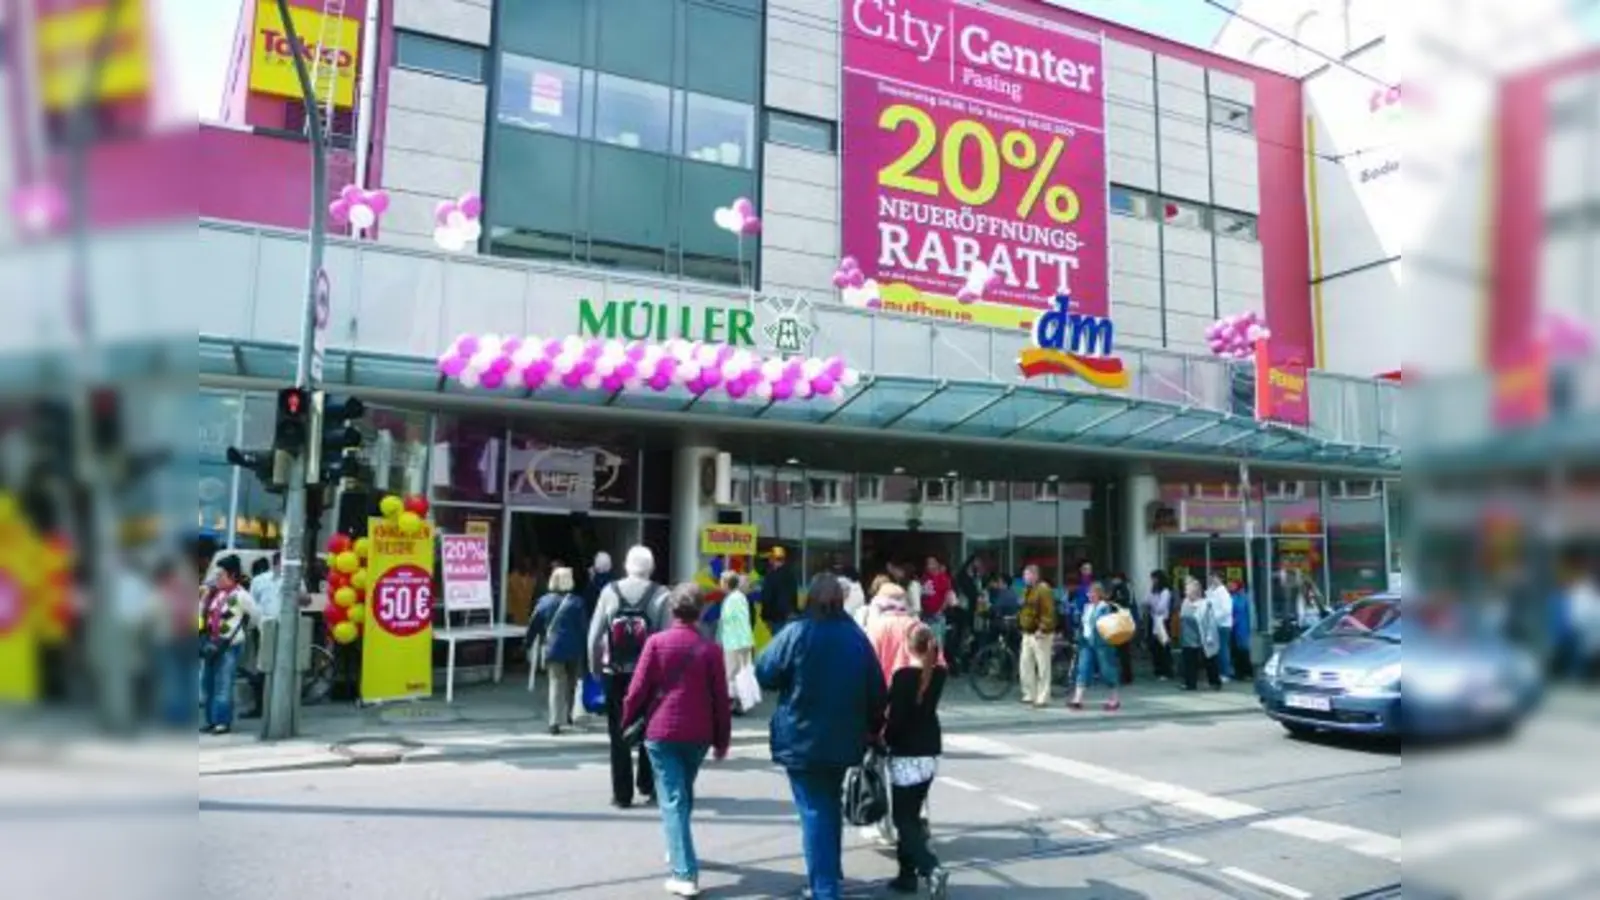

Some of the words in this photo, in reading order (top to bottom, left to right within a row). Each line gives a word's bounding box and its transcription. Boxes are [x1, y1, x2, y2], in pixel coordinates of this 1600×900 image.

[853, 0, 944, 62] City
[960, 24, 1095, 92] Center
[962, 67, 1023, 103] Pasing
[877, 103, 1080, 223] 20%
[878, 195, 1085, 251] NEUERÖFFNUNGS-
[877, 222, 1079, 295] RABATT
[577, 298, 756, 346] MÜLLER
[1037, 295, 1113, 355] dm
[445, 539, 488, 561] 20%
[380, 586, 411, 620] 50
[415, 585, 430, 620] €
